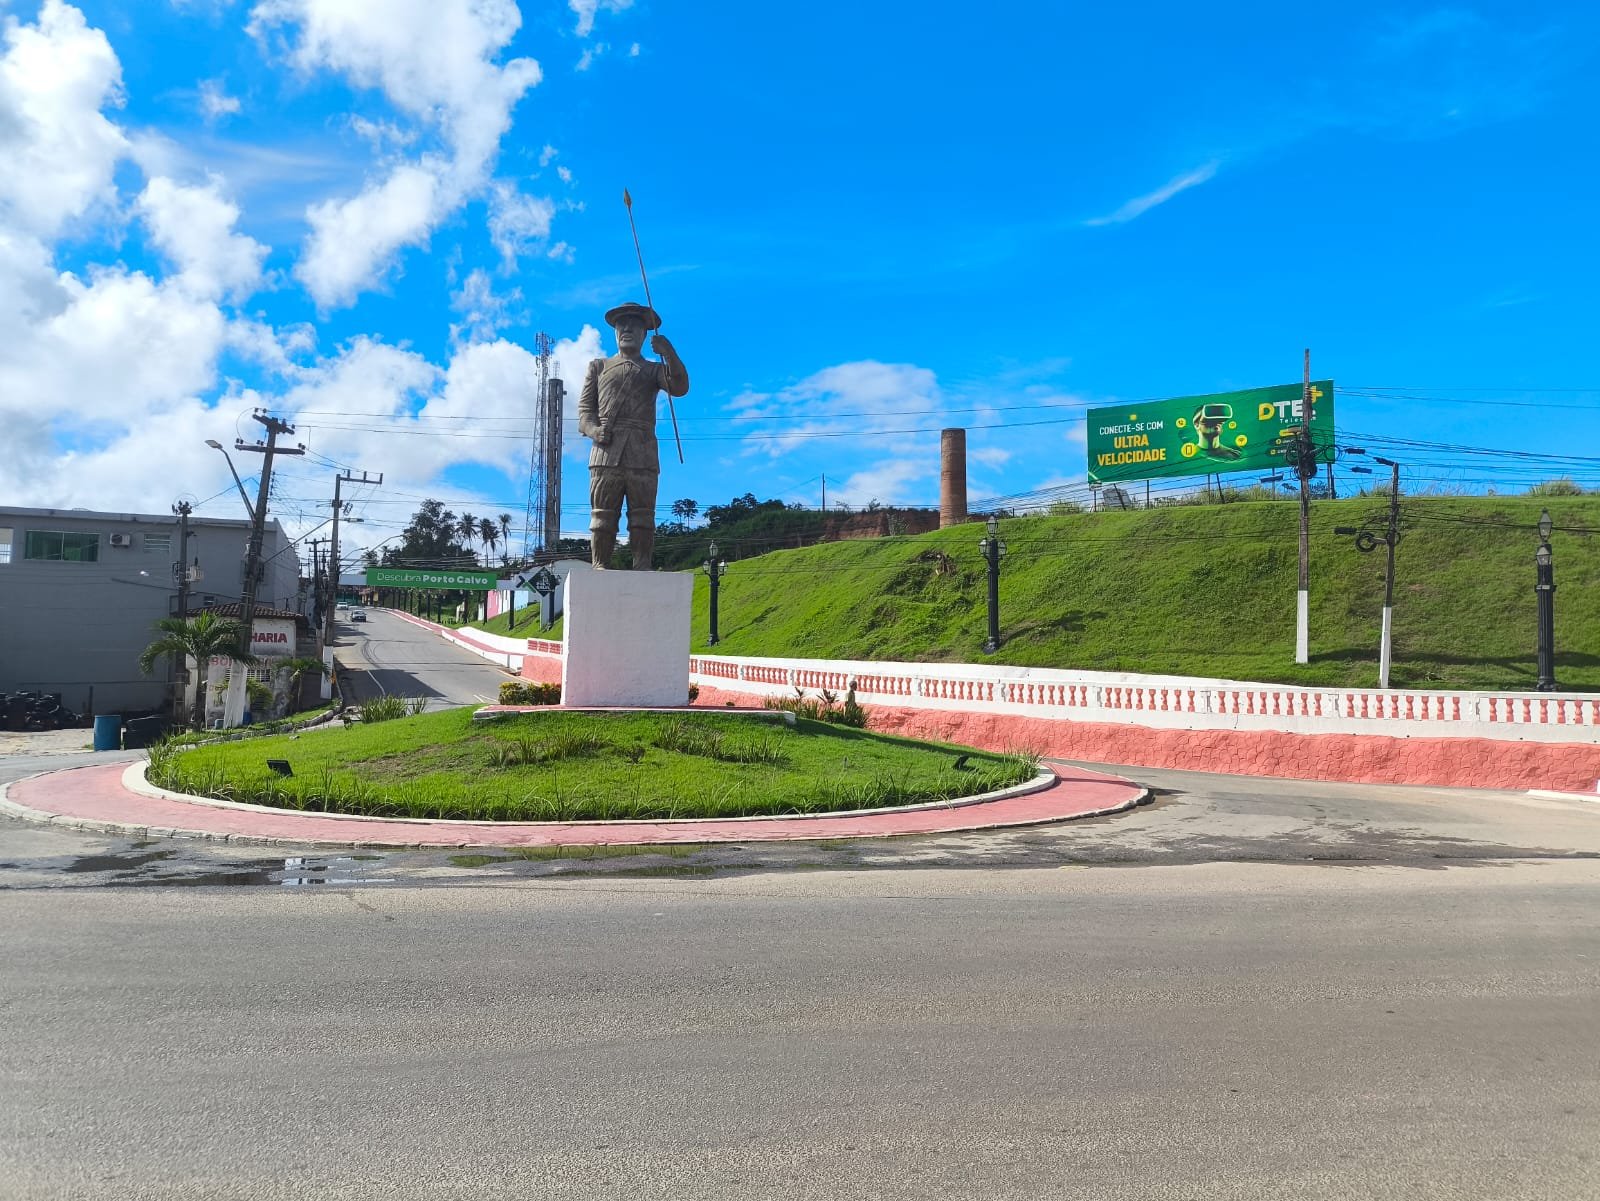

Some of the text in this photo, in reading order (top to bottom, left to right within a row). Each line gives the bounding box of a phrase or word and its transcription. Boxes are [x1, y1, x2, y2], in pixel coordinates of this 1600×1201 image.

[1258, 399, 1317, 421] DTE
[1099, 420, 1164, 435] CONECTE-SE COM
[1113, 434, 1149, 449] ULTRA
[1097, 448, 1167, 466] VELOCIDADE
[377, 572, 488, 585] Descubra Porto Calvo
